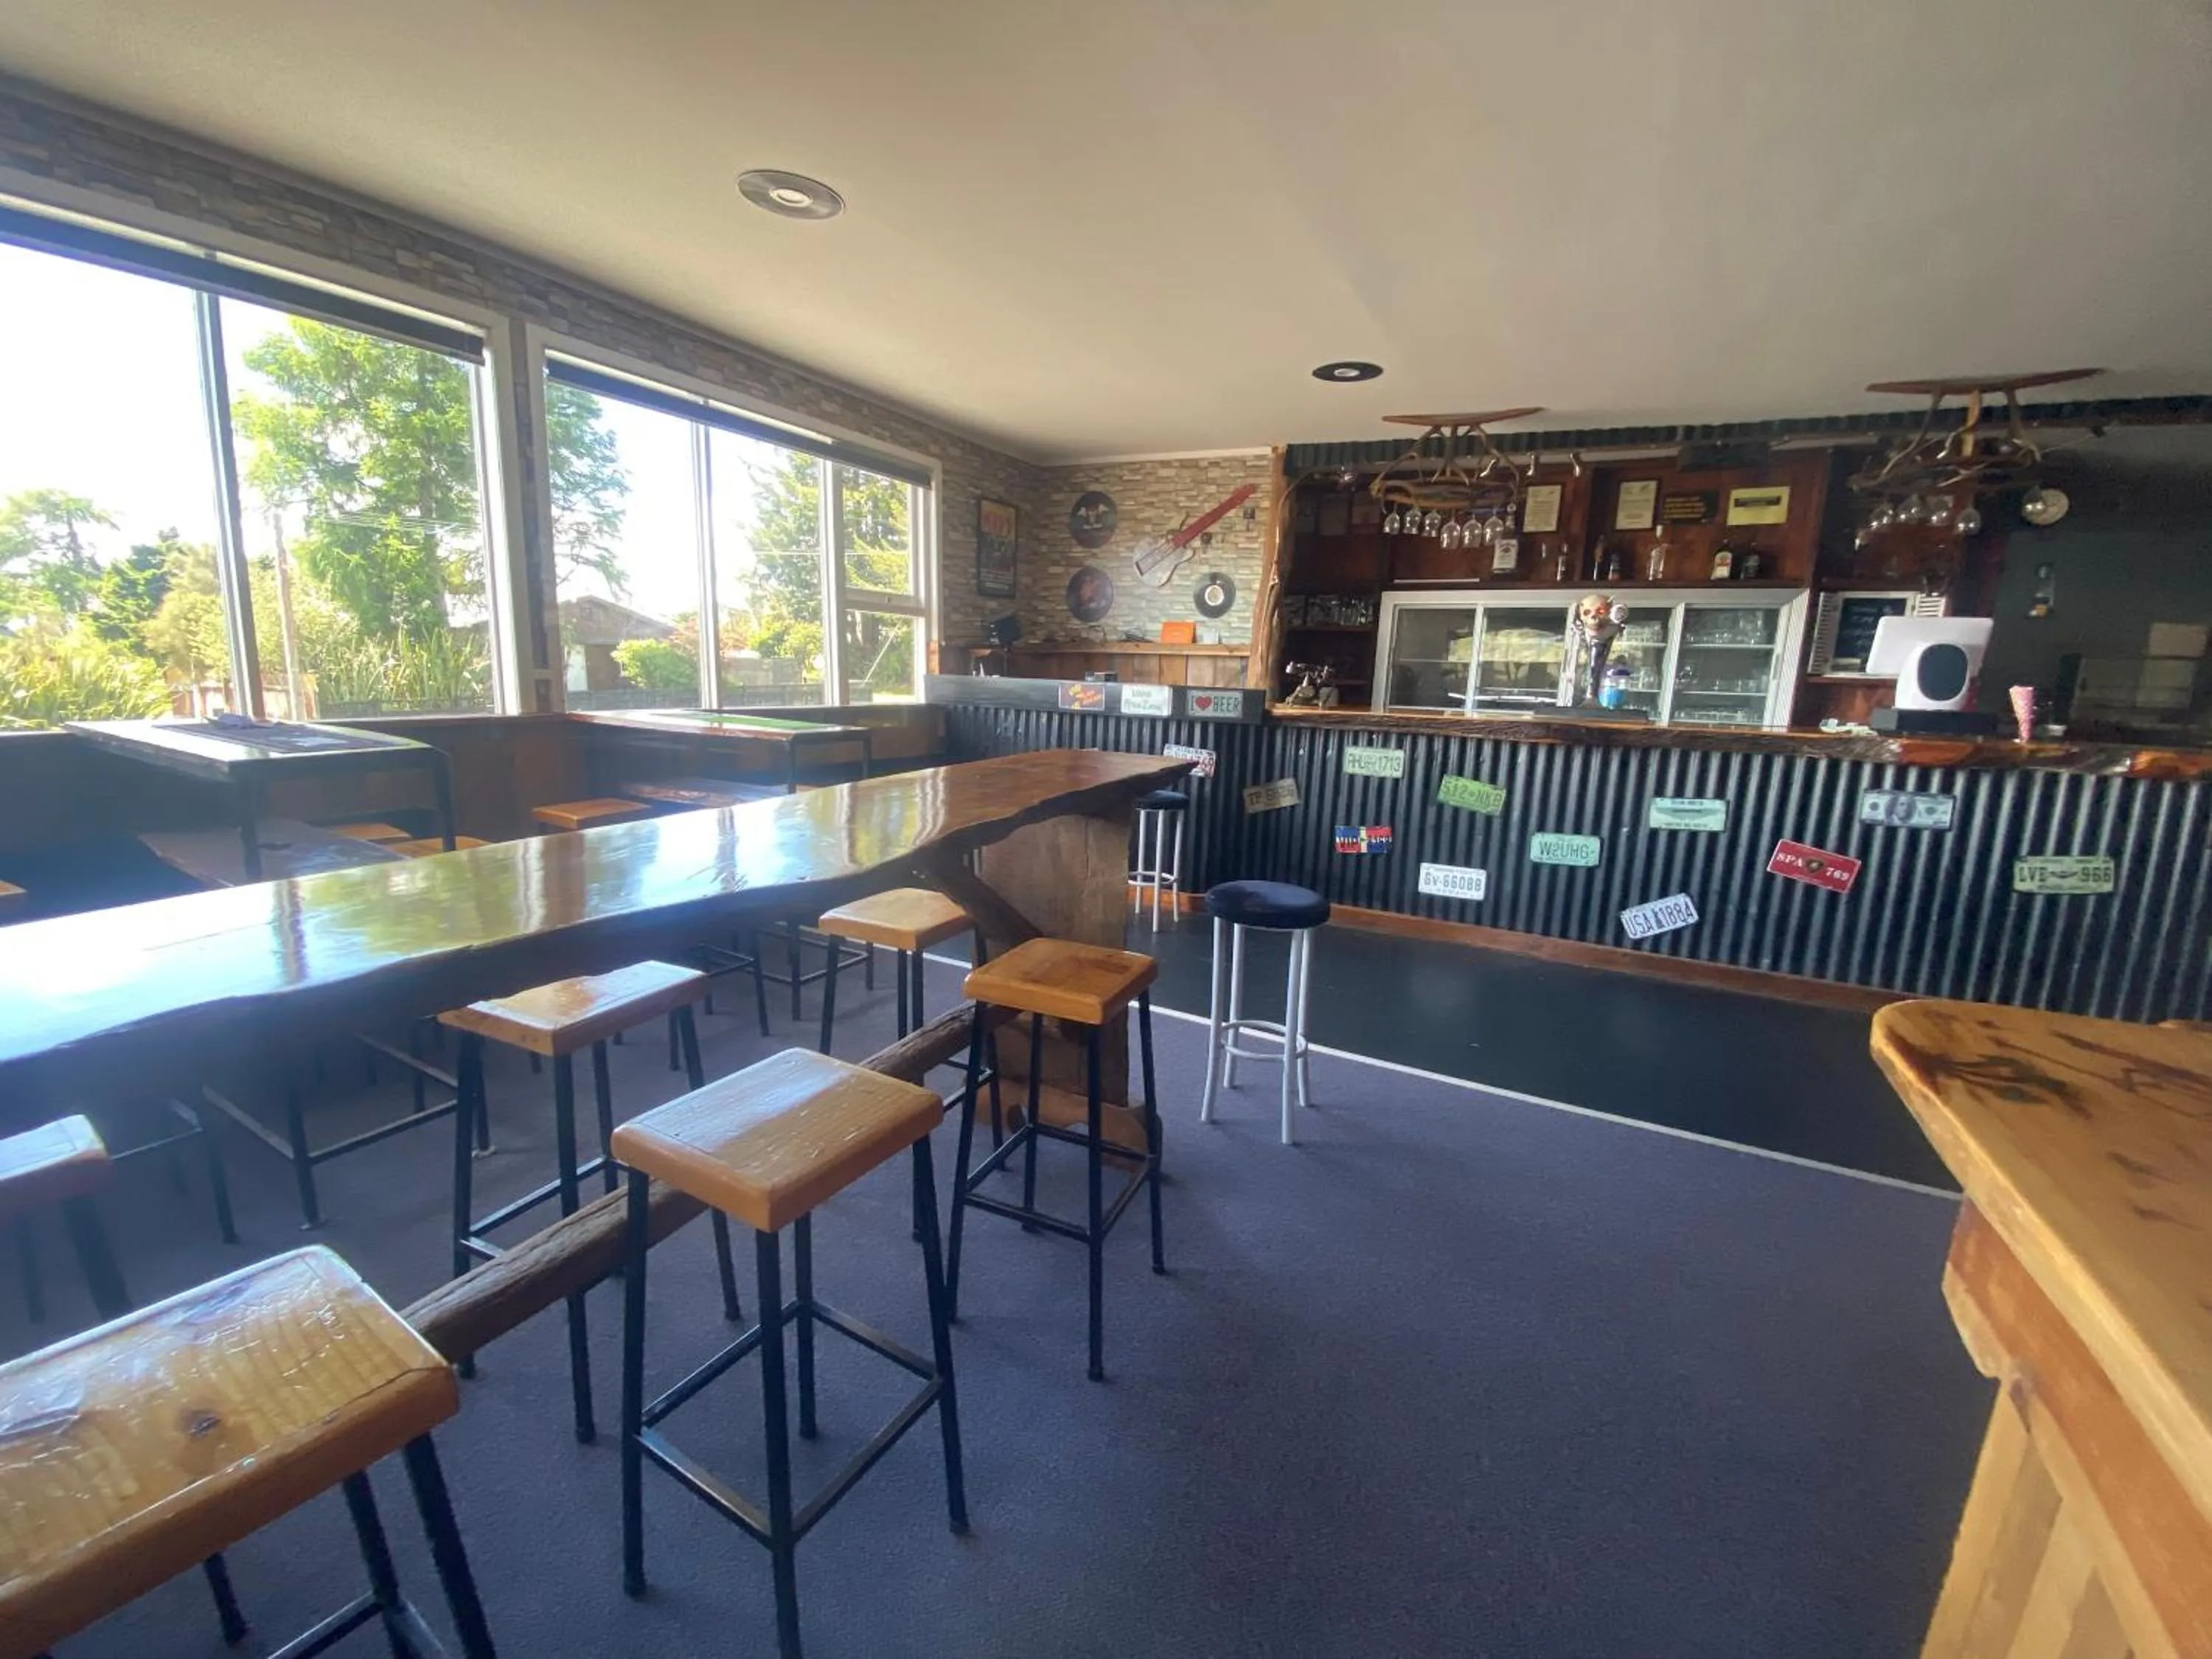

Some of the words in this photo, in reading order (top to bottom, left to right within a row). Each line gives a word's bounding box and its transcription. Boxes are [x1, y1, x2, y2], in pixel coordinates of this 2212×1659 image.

[1213, 696, 1239, 713] BEER
[1776, 852, 1804, 868] SPA
[2018, 866, 2048, 883] LVE
[1624, 912, 1655, 936] USA
